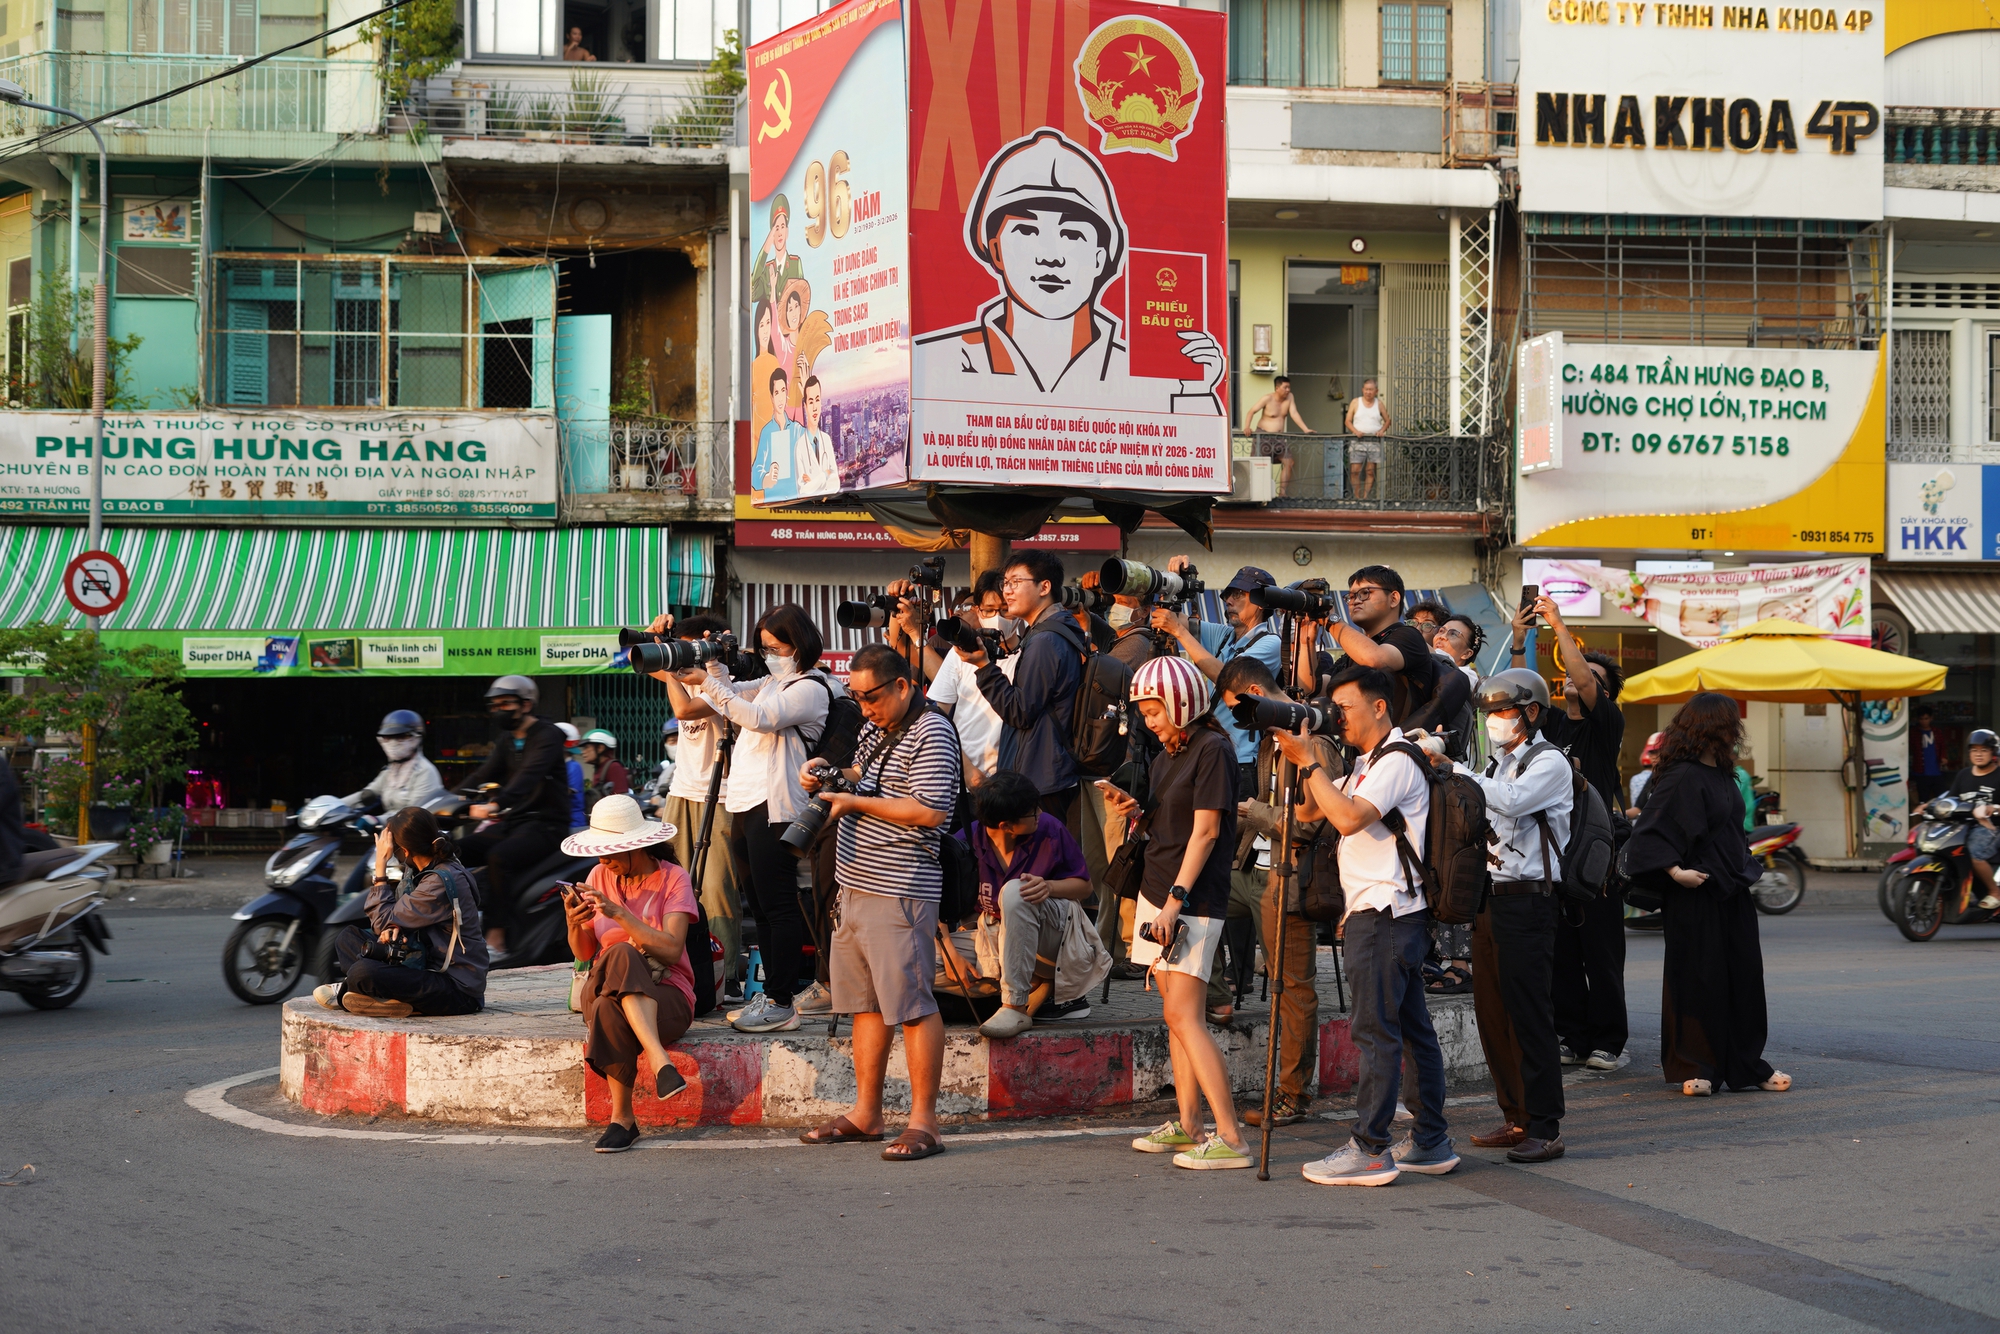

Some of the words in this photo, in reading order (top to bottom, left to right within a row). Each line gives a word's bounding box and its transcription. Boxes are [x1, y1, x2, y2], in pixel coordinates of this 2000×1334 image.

[1616, 2, 1646, 26] TY
[1653, 4, 1714, 28] TNHH
[1723, 6, 1769, 29] NHA
[1778, 8, 1839, 31] KHOA
[1844, 10, 1873, 32] 4P
[1122, 128, 1138, 136] VIỆT
[1140, 130, 1157, 139] NAM
[1535, 91, 1646, 149] NHA
[1654, 95, 1798, 153] KHOA
[1804, 100, 1881, 155] 4P
[804, 150, 852, 249] 96
[854, 190, 880, 224] NĂM
[834, 255, 844, 276] XÂY
[846, 252, 860, 274] DỰNG
[862, 243, 878, 267] ĐẢNG
[834, 280, 841, 301] VÀ
[842, 278, 849, 302] HỆ
[850, 272, 868, 297] THỐNG
[870, 268, 888, 291] CHÍNH
[889, 266, 898, 288] TRỊ
[834, 306, 852, 327] TRONG
[853, 302, 868, 325] SẠCH
[1146, 300, 1188, 313] PHIẾU
[1174, 315, 1194, 328] CỬ
[834, 332, 849, 353] VỮNG
[850, 328, 867, 352] MẠNH
[868, 322, 883, 344] TOÀN
[1590, 364, 1629, 384] 484
[1636, 355, 1689, 386] TRẦN
[1694, 363, 1754, 388] HƯNG
[1760, 368, 1805, 392] ĐẠO
[1812, 369, 1830, 392] B,
[1562, 388, 1638, 416] HƯỜNG
[1646, 395, 1694, 422] CHỢ
[102, 418, 145, 430] NHÀ
[153, 416, 225, 431] THUỐC
[252, 420, 296, 432] HỌC
[966, 414, 993, 428] THAM
[996, 416, 1012, 429] GIA
[1014, 414, 1033, 430] BẦU
[1036, 414, 1050, 431] CỬ
[1050, 419, 1066, 434] ĐẠI
[1068, 416, 1090, 433] BIỂU
[1092, 418, 1116, 435] QUỐC
[1119, 420, 1134, 438] HỘI
[1136, 422, 1160, 437] KHÓA
[1162, 425, 1177, 438] XVI
[36, 431, 196, 459] PHÙNG
[214, 434, 342, 460] HƯNG
[923, 431, 936, 446] VÀ
[938, 434, 954, 449] ĐẠI
[957, 430, 978, 448] BIỂU
[982, 434, 997, 451] HỘI
[1000, 433, 1026, 450] ĐỒNG
[1028, 436, 1054, 451] NHÂN
[1057, 438, 1076, 452] DÂN
[1079, 438, 1097, 453] CÁC
[1100, 438, 1118, 454] CẤP
[1120, 442, 1149, 458] NHIỆM
[1152, 443, 1164, 457] KỲ
[1166, 445, 1187, 458] 2026
[1196, 447, 1216, 459] 2031
[1582, 432, 1620, 452] ĐT:
[1632, 433, 1662, 454] 09
[1667, 435, 1724, 455] 6767
[1732, 436, 1790, 456] 5158
[77, 464, 116, 476] BN
[124, 464, 163, 476] CAO
[169, 464, 207, 476] ĐƠN
[214, 463, 266, 477] HOÀN
[273, 464, 310, 477] TÁN
[316, 464, 348, 480] NỘI
[354, 467, 384, 480] ĐỊA
[391, 465, 415, 478] VÀ
[421, 468, 479, 481] NGOẠI
[486, 466, 536, 481] NHẬP
[927, 452, 939, 466] LÀ
[942, 452, 972, 468] QUYỀN
[976, 456, 993, 471] LỢI,
[996, 455, 1026, 470] TRÁCH
[1028, 457, 1059, 474] NHIỆM
[1061, 458, 1094, 473] THIÊNG
[1096, 459, 1122, 475] LIÊNG
[1125, 460, 1143, 476] CỦA
[1146, 461, 1162, 476] MỖI
[1165, 463, 1189, 478] CÔNG
[1192, 464, 1213, 478] DÂN!
[27, 486, 40, 495] TẠ
[44, 486, 81, 494] HƯƠNG
[378, 486, 402, 498] GIẤY
[406, 487, 433, 498] PHÉP
[436, 486, 454, 498] SỐ:
[27, 499, 70, 510] TRẦN
[118, 502, 150, 512] ĐẠO
[154, 502, 164, 510] B
[368, 504, 391, 513] ĐT:
[395, 504, 458, 513] 38550526
[470, 504, 534, 514] 38556004
[771, 529, 793, 539] 488
[1854, 532, 1874, 543] 775
[1902, 526, 1967, 550] HKK
[189, 651, 223, 663] Super
[226, 650, 252, 661] DHA
[402, 644, 420, 652] linh
[422, 644, 437, 652] chi
[448, 648, 492, 656] NISSAN
[497, 647, 536, 656] REISHI
[546, 648, 580, 661] Super
[582, 648, 608, 658] DHA
[387, 655, 420, 663] Nissan
